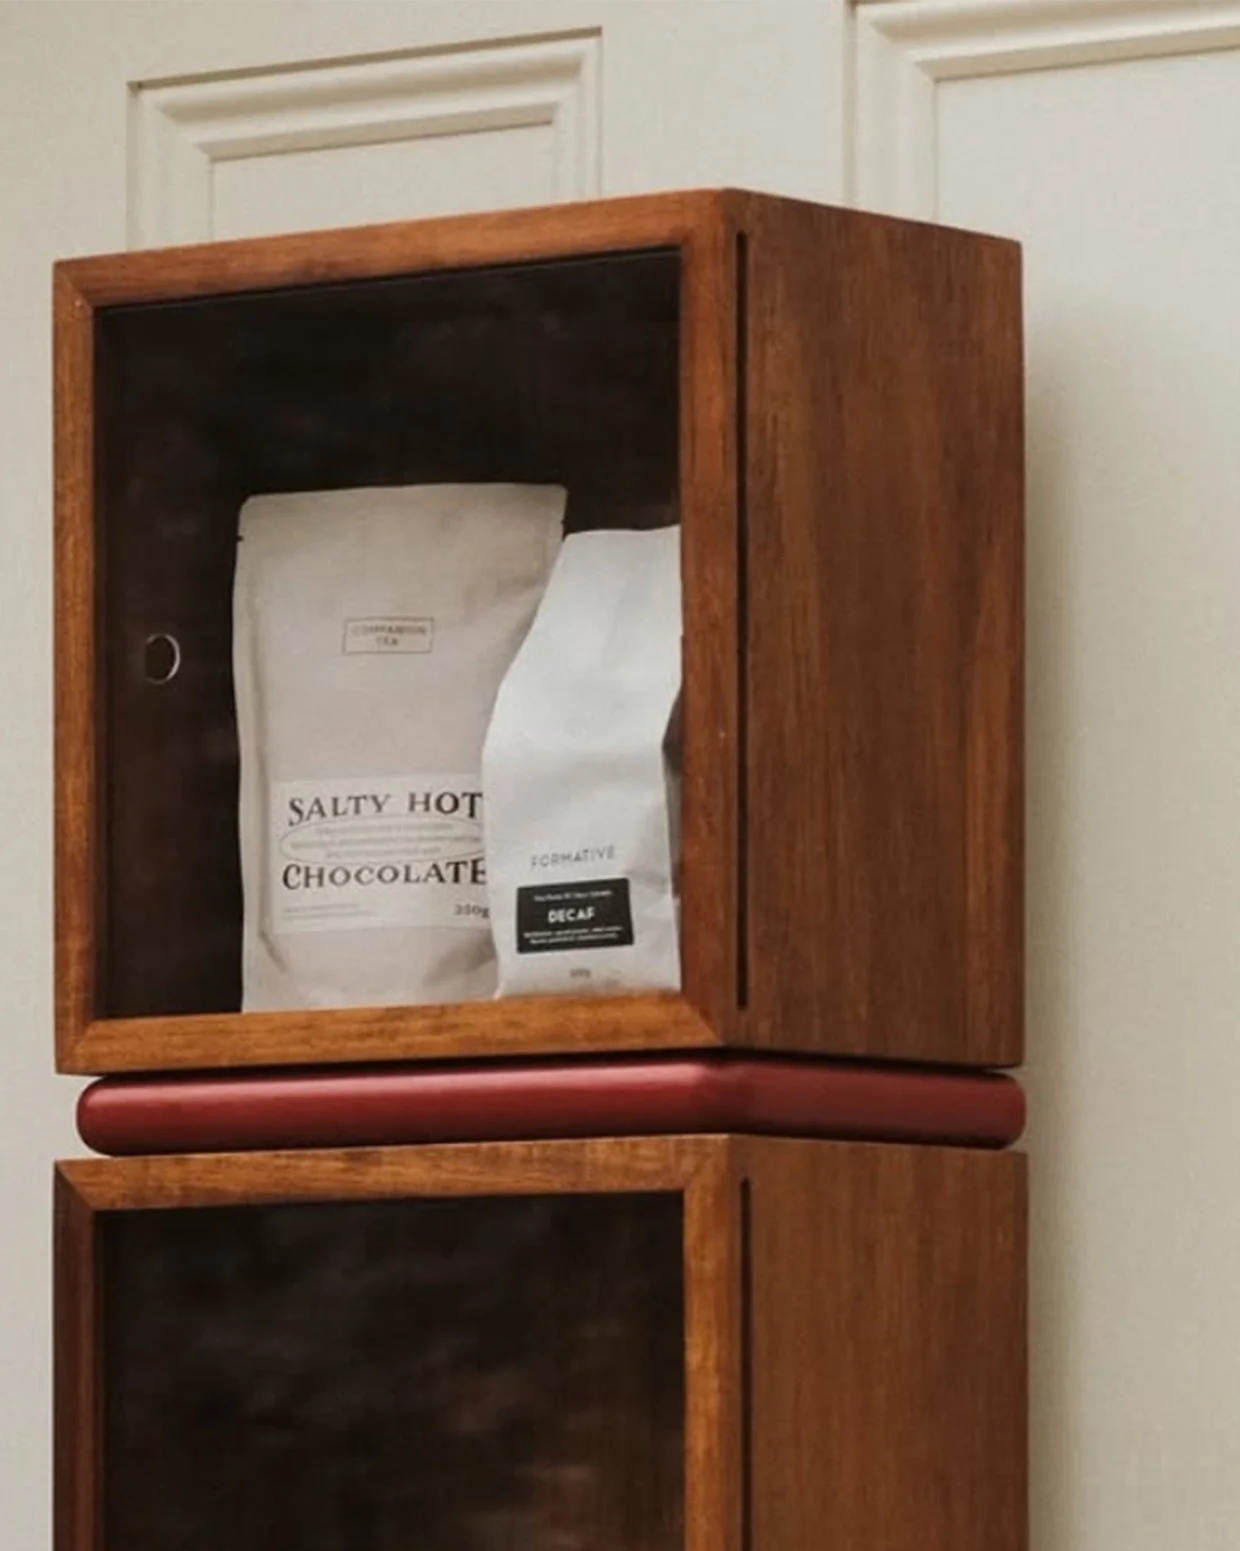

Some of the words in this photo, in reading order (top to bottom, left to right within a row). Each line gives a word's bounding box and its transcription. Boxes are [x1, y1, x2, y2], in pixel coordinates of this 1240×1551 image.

[288, 794, 391, 826] SALTY
[408, 791, 483, 819] HOT
[531, 846, 616, 869] FORMATIVE
[282, 857, 487, 890] CHOCOLATE
[548, 906, 594, 923] DECAF
